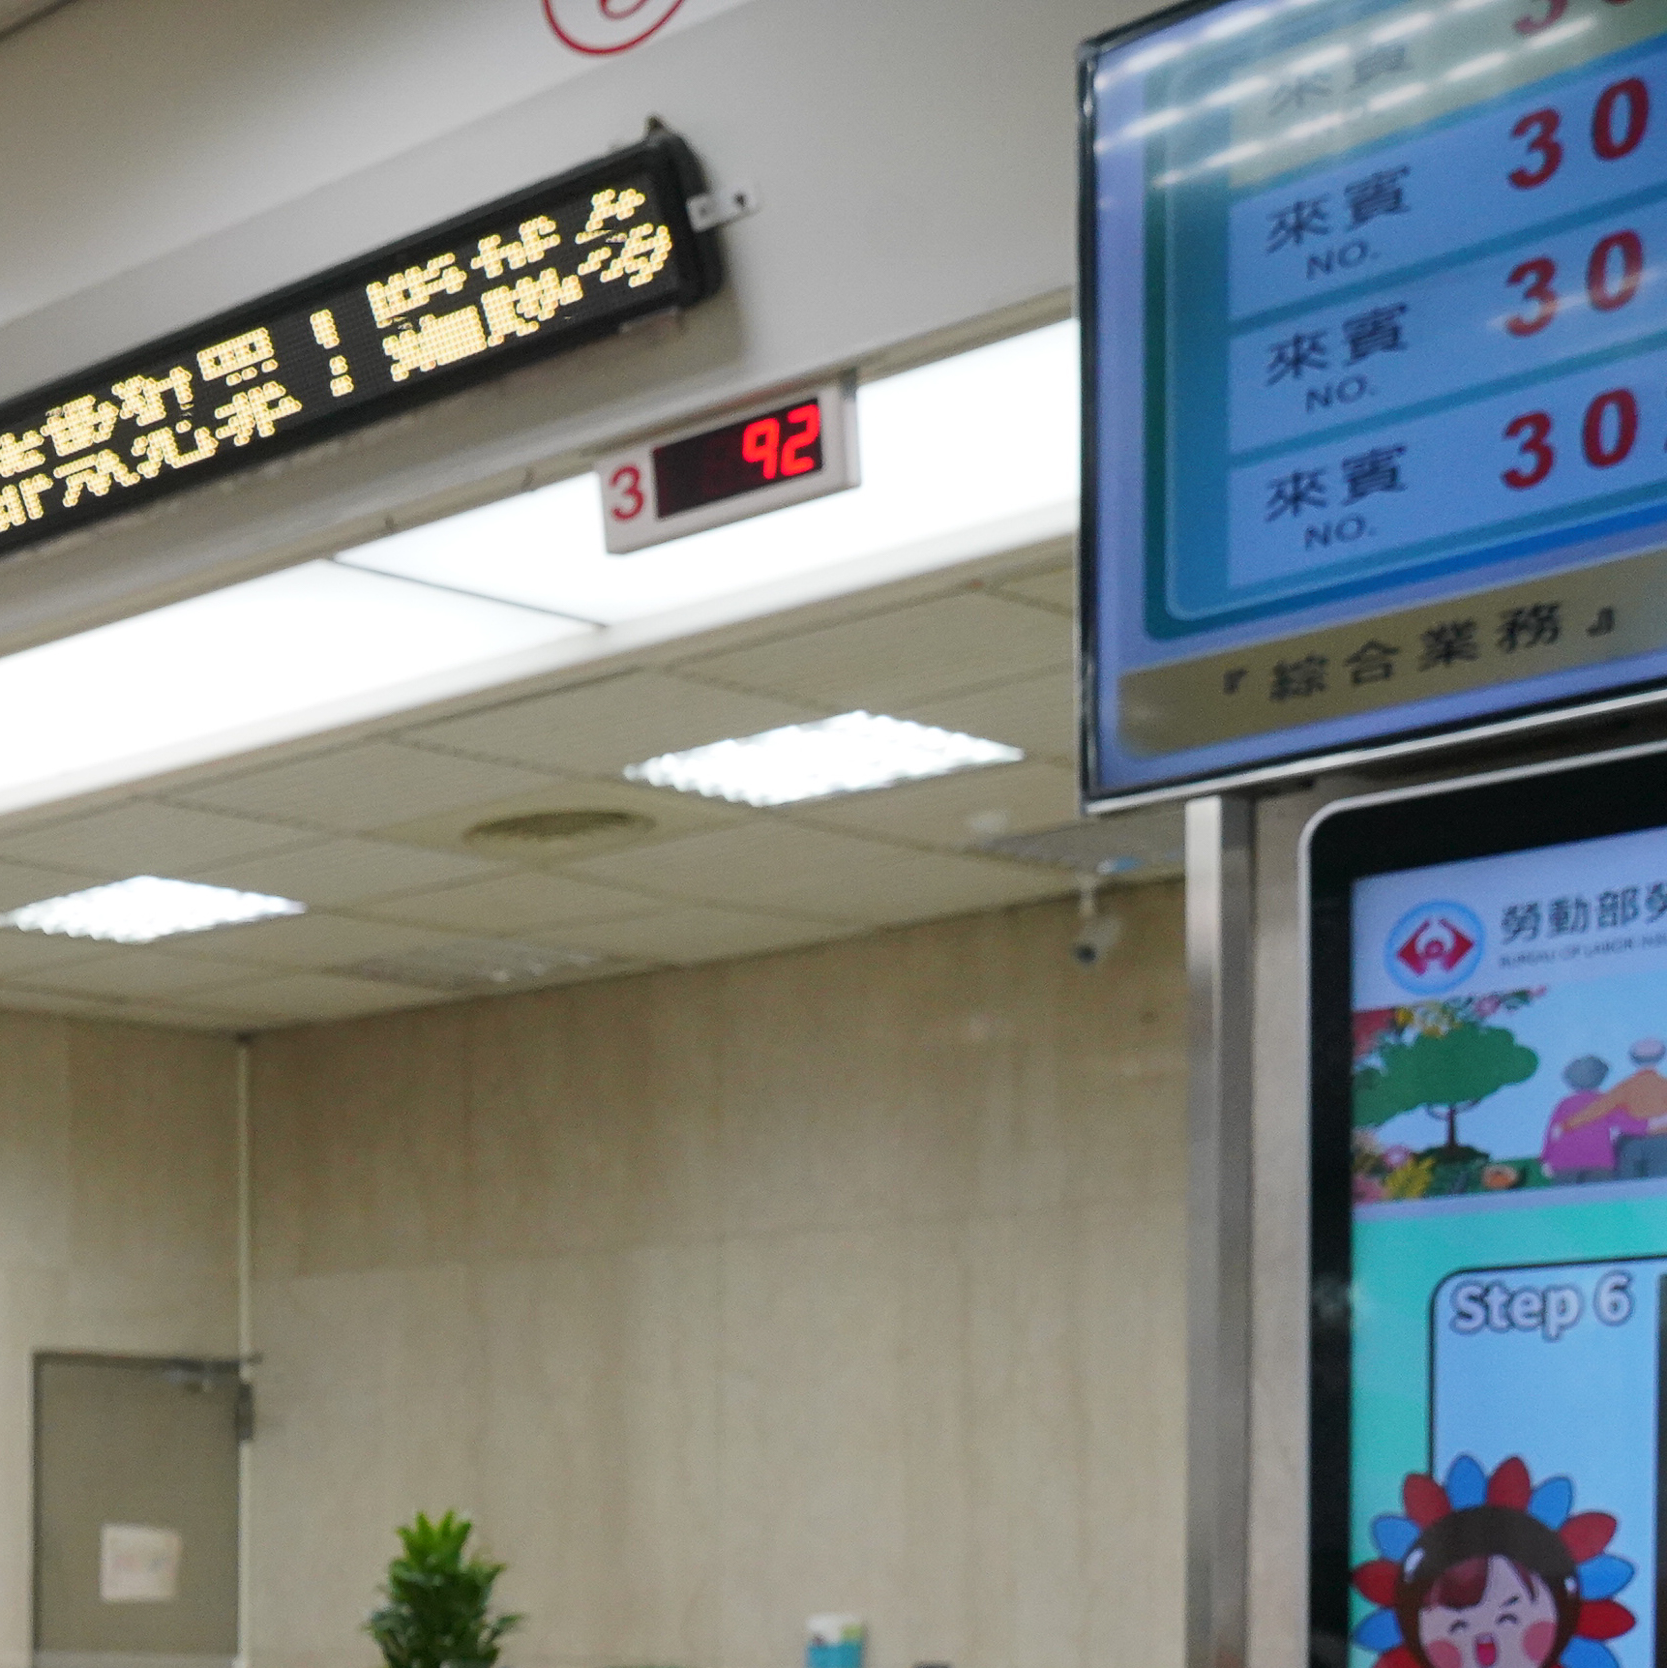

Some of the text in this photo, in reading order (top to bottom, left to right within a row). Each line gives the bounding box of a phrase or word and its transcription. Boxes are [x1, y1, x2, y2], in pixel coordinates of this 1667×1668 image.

[741, 404, 820, 481] 92
[609, 464, 644, 521] 3
[1450, 1273, 1632, 1339] Step 6
